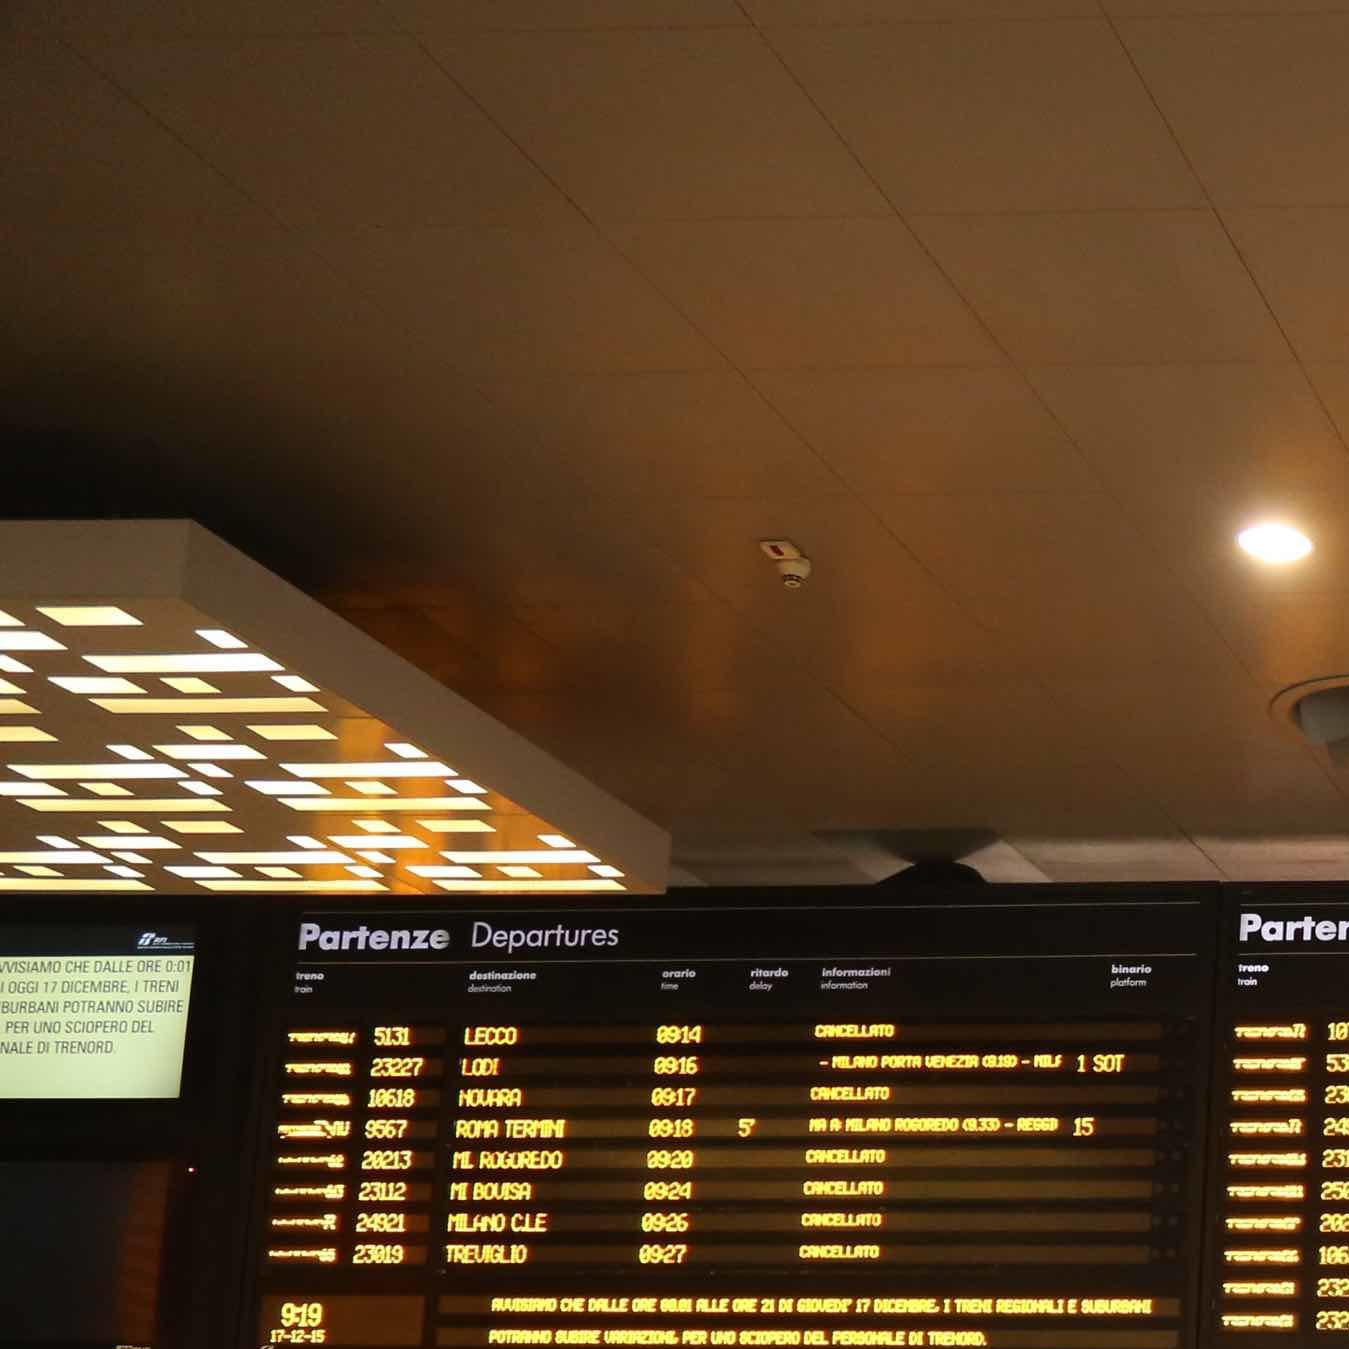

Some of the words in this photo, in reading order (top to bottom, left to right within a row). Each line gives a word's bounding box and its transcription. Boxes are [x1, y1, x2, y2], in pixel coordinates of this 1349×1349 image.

[299, 923, 449, 950] Partenze
[471, 922, 619, 954] Departures
[1238, 963, 1269, 972] treno
[1238, 977, 1257, 986] train
[464, 1027, 517, 1045] LECCO
[459, 1089, 521, 1107] NOVARA
[456, 1120, 499, 1138] ROMA
[1073, 1117, 1094, 1136] 15
[479, 1151, 563, 1169] ROGOREDO
[473, 1183, 531, 1200] BOVISA
[448, 1213, 506, 1232] MILANO
